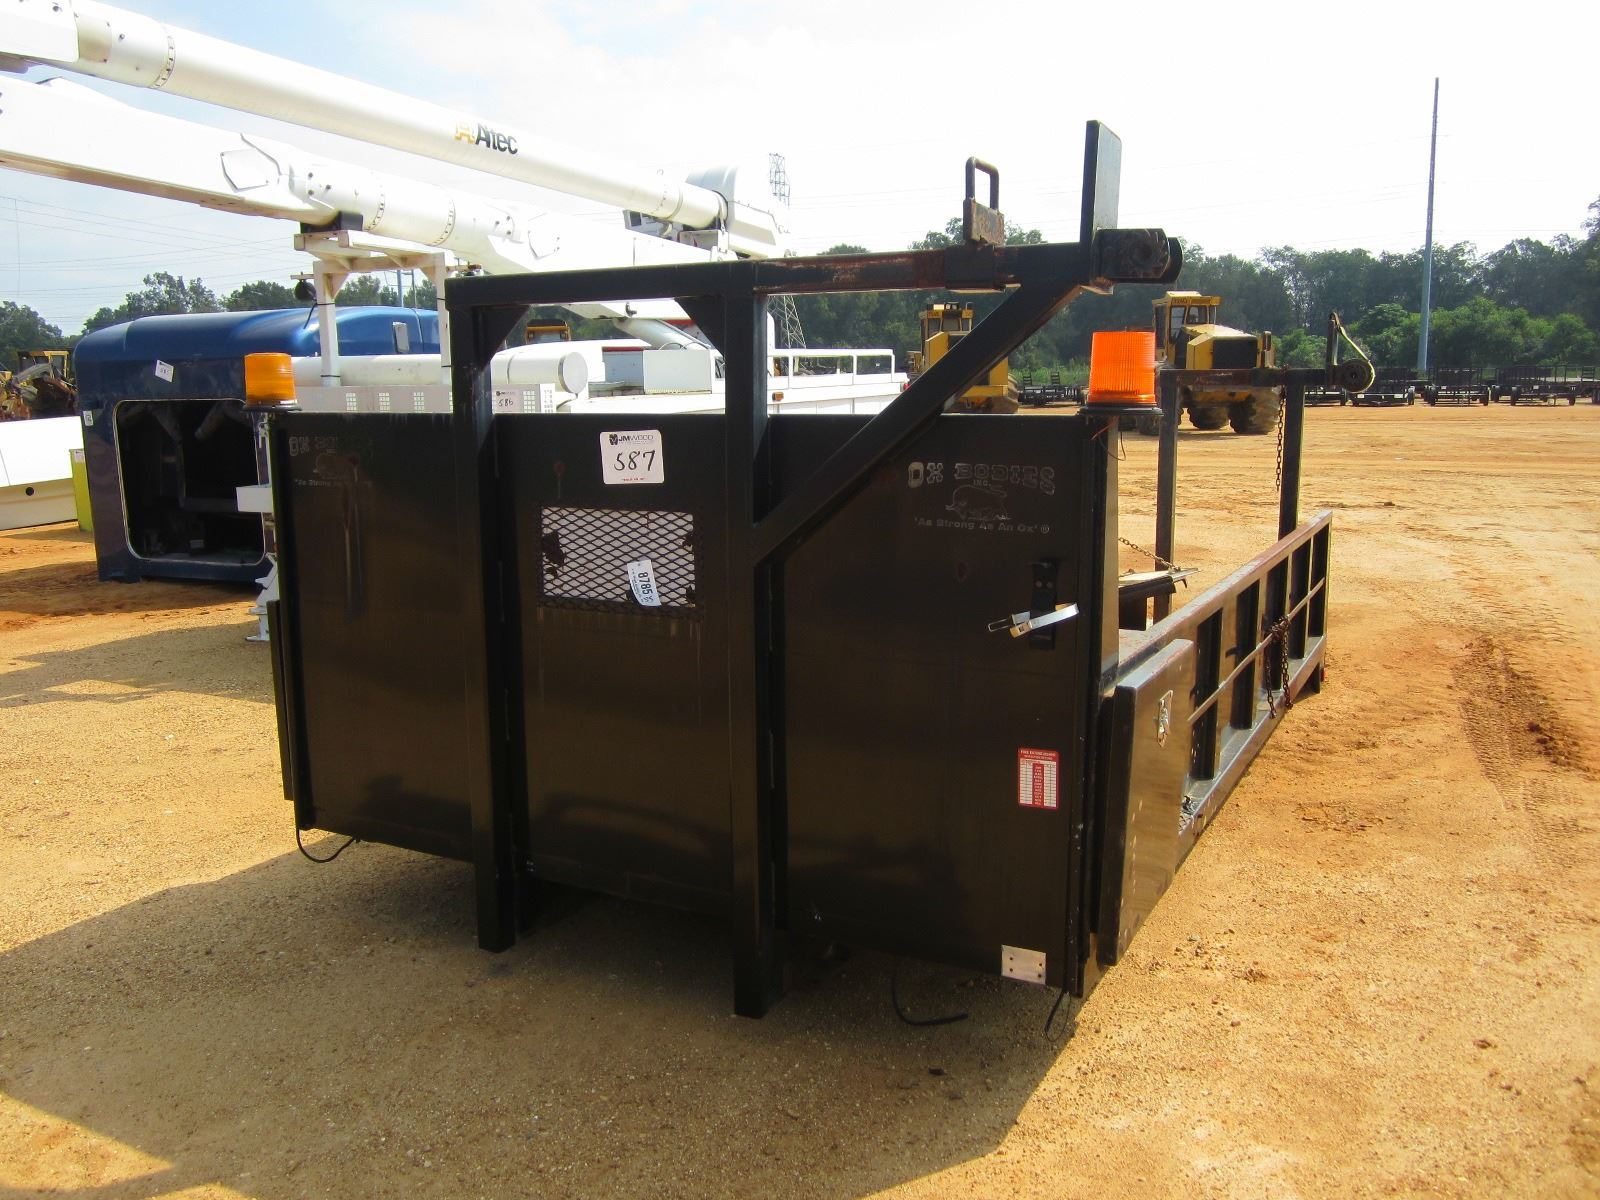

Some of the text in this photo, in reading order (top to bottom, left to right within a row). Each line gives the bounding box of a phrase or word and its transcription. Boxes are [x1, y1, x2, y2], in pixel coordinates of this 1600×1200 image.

[475, 122, 519, 155] Altec
[613, 449, 656, 472] 587
[907, 461, 1056, 496] OX BODIES
[936, 518, 975, 531] Strong
[978, 520, 994, 532] As
[997, 522, 1014, 532] An
[637, 571, 655, 596] 8785
